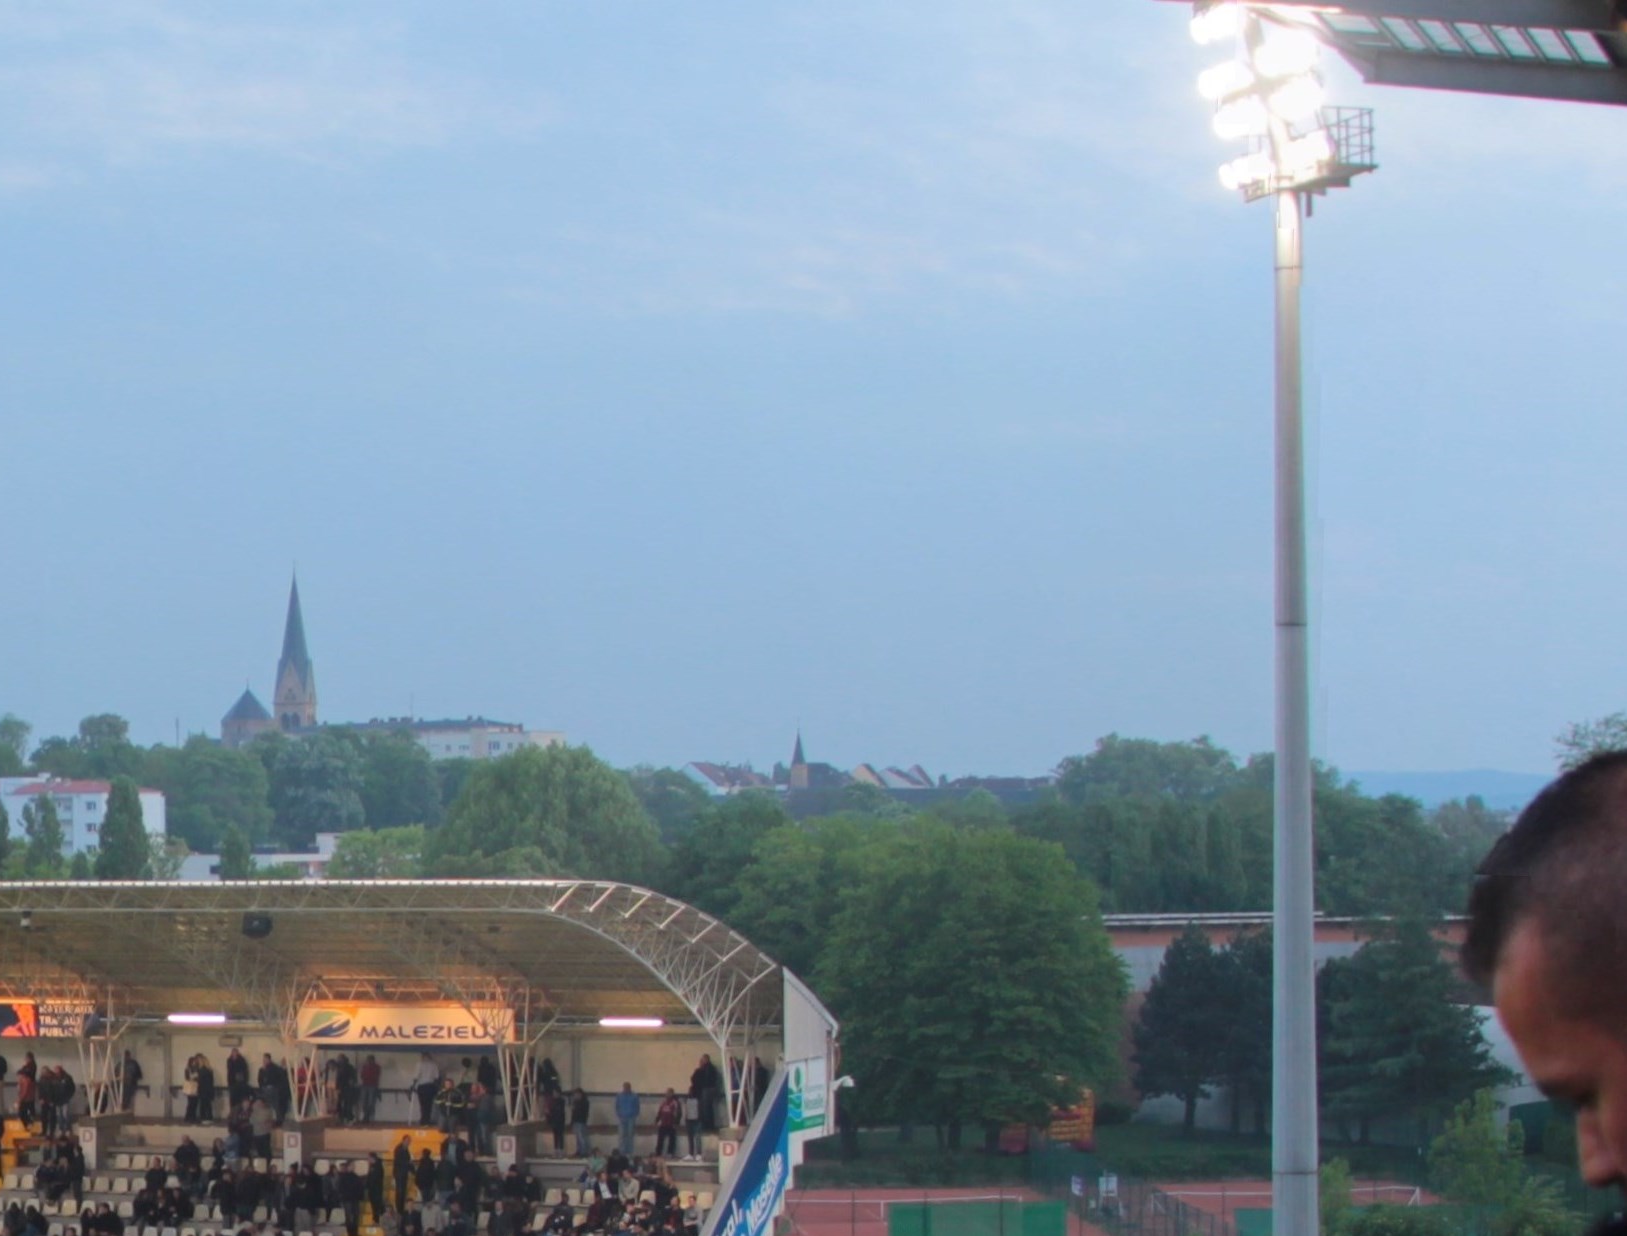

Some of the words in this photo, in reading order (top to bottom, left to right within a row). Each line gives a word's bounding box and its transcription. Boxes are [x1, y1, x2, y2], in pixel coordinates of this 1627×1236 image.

[359, 1024, 506, 1041] MALEZIEUX
[500, 1138, 512, 1152] D
[723, 1143, 734, 1156] D
